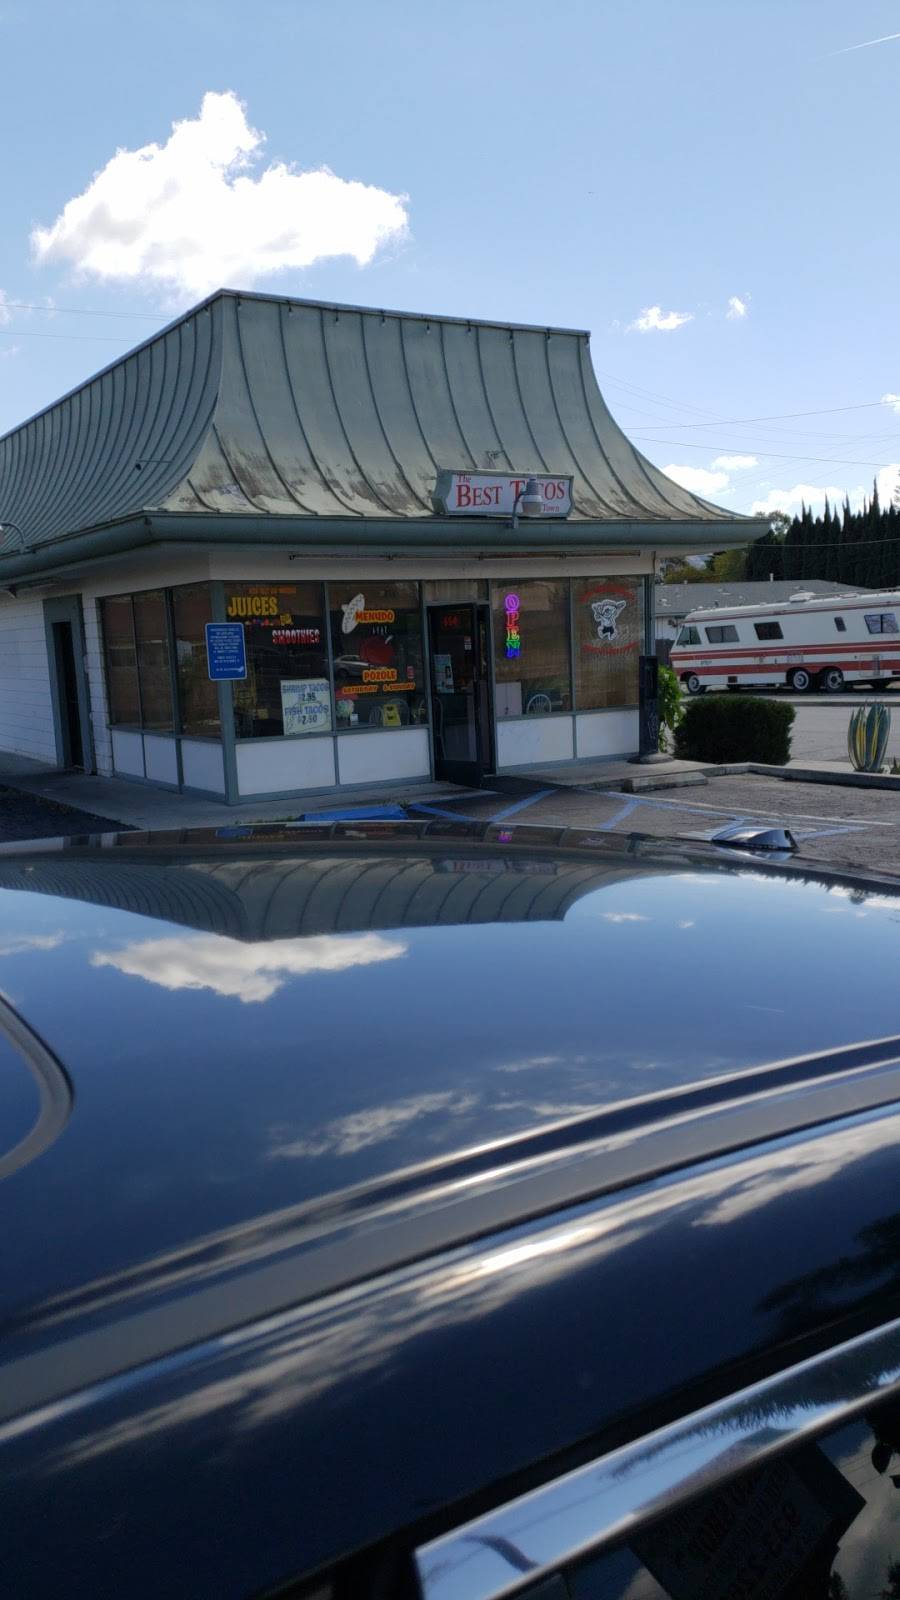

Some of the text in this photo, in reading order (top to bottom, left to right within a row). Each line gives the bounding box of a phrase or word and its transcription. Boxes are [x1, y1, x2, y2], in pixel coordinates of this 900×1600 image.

[457, 473, 472, 483] The
[455, 484, 503, 508] BEST
[228, 596, 278, 616] JUICES
[356, 610, 395, 623] MENUDO
[505, 593, 520, 657] OPEN
[271, 629, 320, 645] SMOOTHIES
[362, 667, 398, 683] POZOLE
